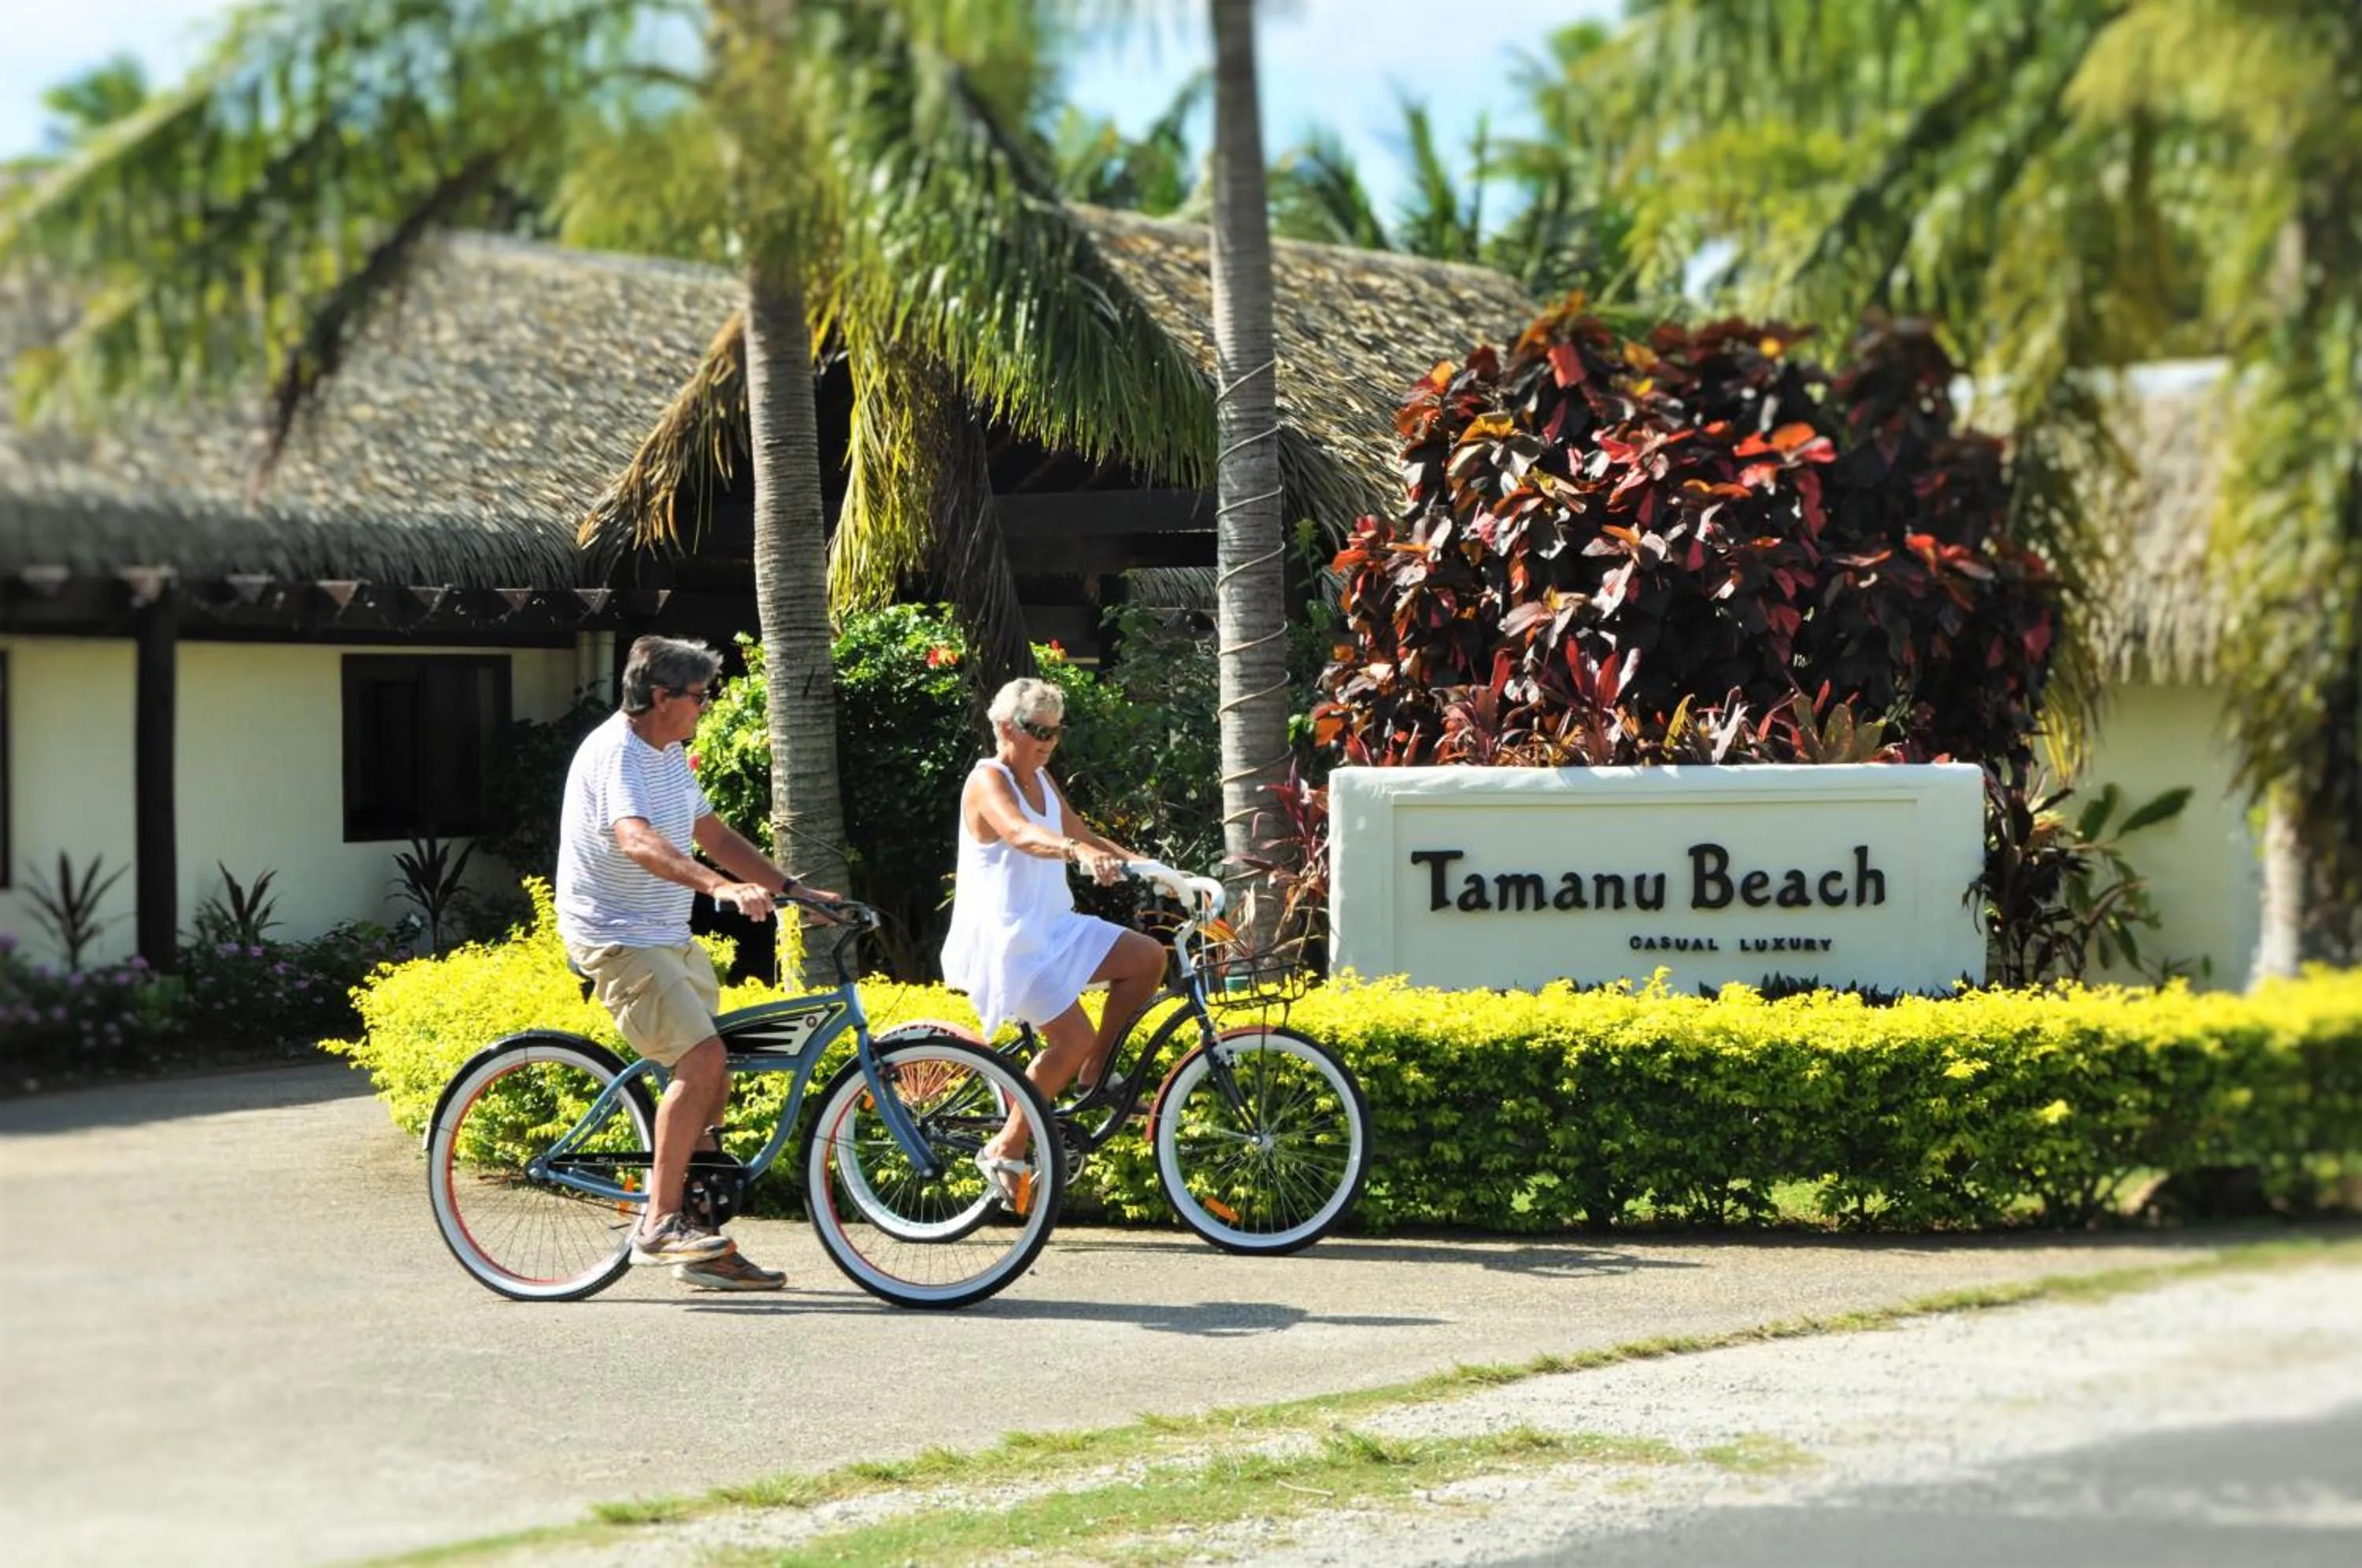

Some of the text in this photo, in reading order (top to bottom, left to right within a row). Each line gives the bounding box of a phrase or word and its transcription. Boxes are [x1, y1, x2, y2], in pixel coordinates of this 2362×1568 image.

[1410, 842, 1886, 913] Tamanu Beach
[1629, 934, 1833, 952] CASUAL LUXURY
